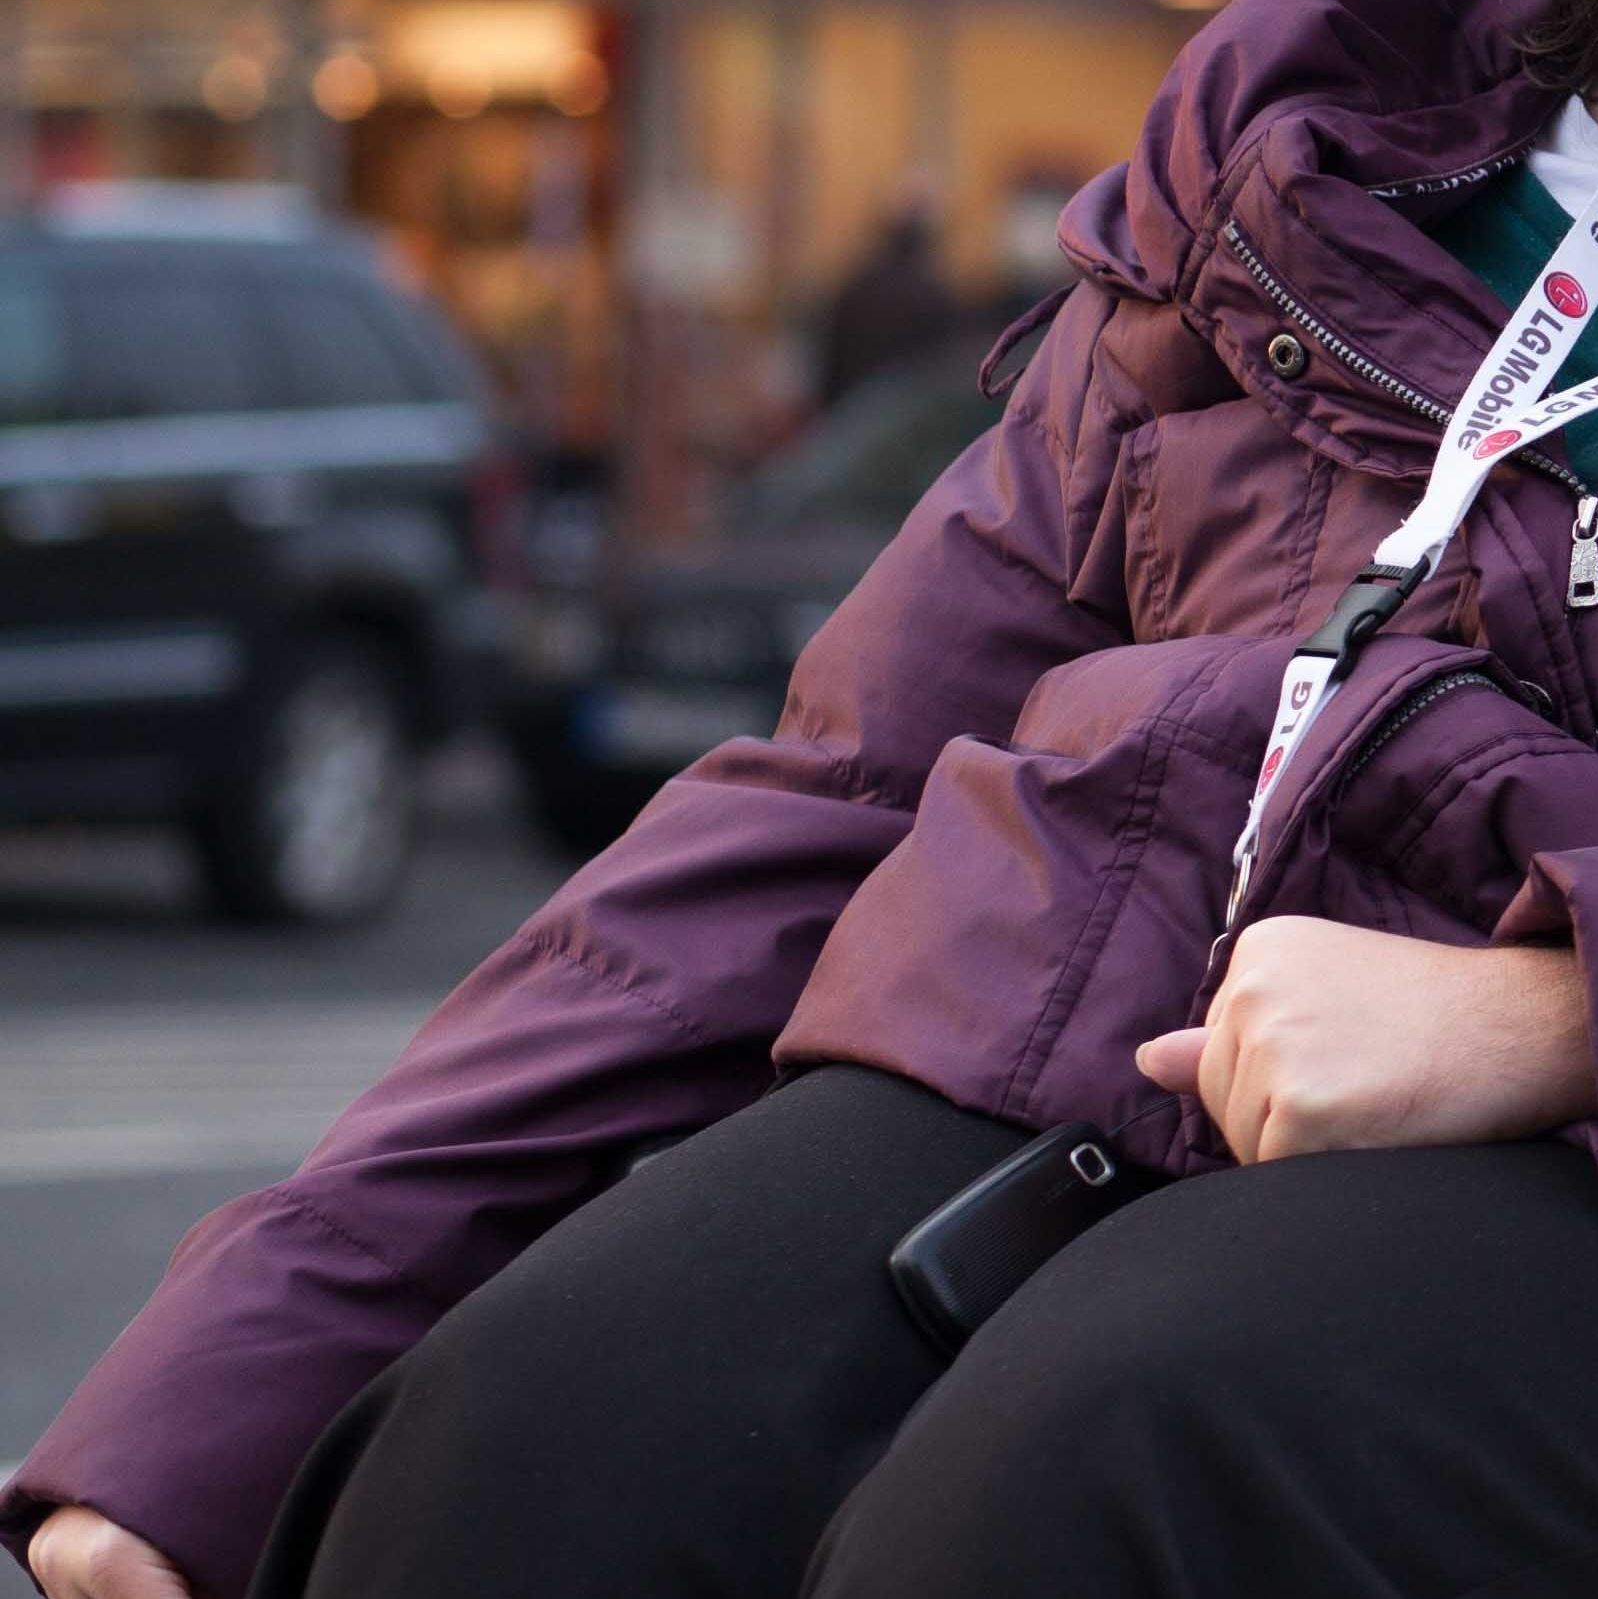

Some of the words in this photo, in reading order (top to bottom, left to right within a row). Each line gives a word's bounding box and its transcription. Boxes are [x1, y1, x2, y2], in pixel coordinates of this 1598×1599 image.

[1518, 309, 1563, 354] LG
[1458, 348, 1539, 450] Mobile
[1520, 400, 1579, 426] LG
[1280, 681, 1313, 735] LG
